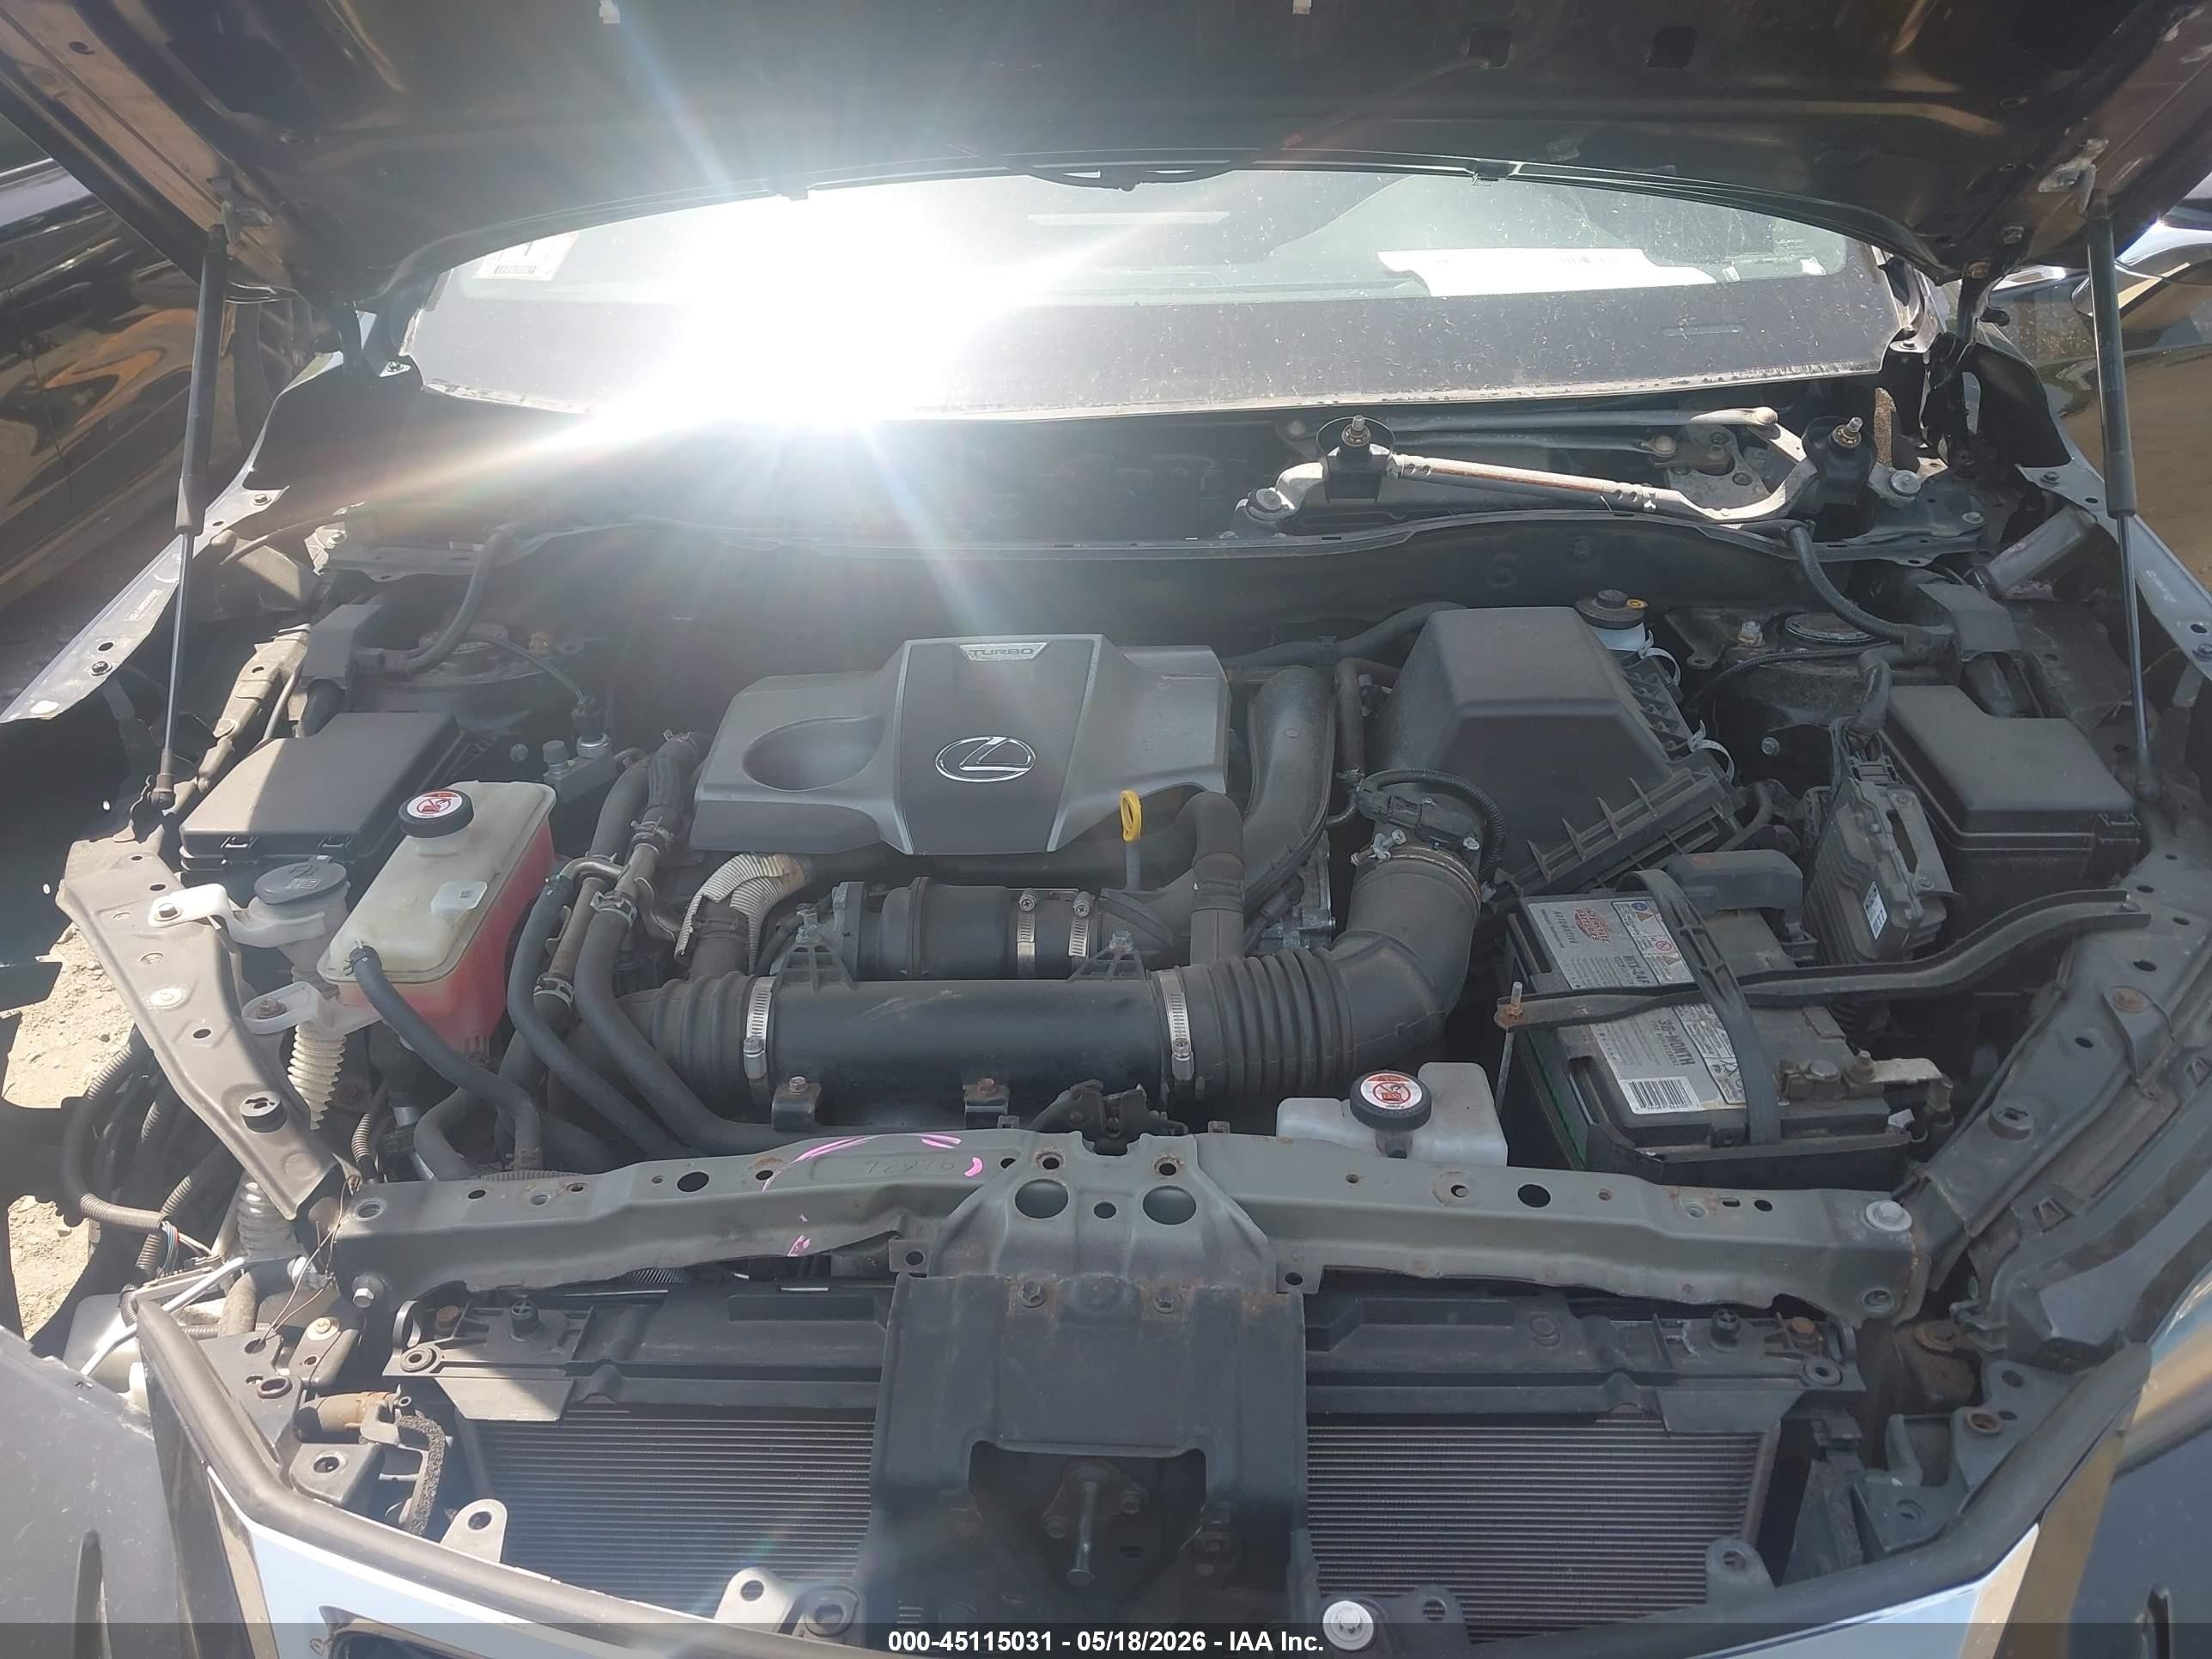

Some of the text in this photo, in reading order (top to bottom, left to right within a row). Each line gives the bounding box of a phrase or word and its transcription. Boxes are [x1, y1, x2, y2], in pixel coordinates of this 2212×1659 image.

[1573, 908, 1598, 941] BATTERIES
[1584, 907, 1611, 943] INTERSTATE
[1657, 1019, 1696, 1066] 36-MONTH
